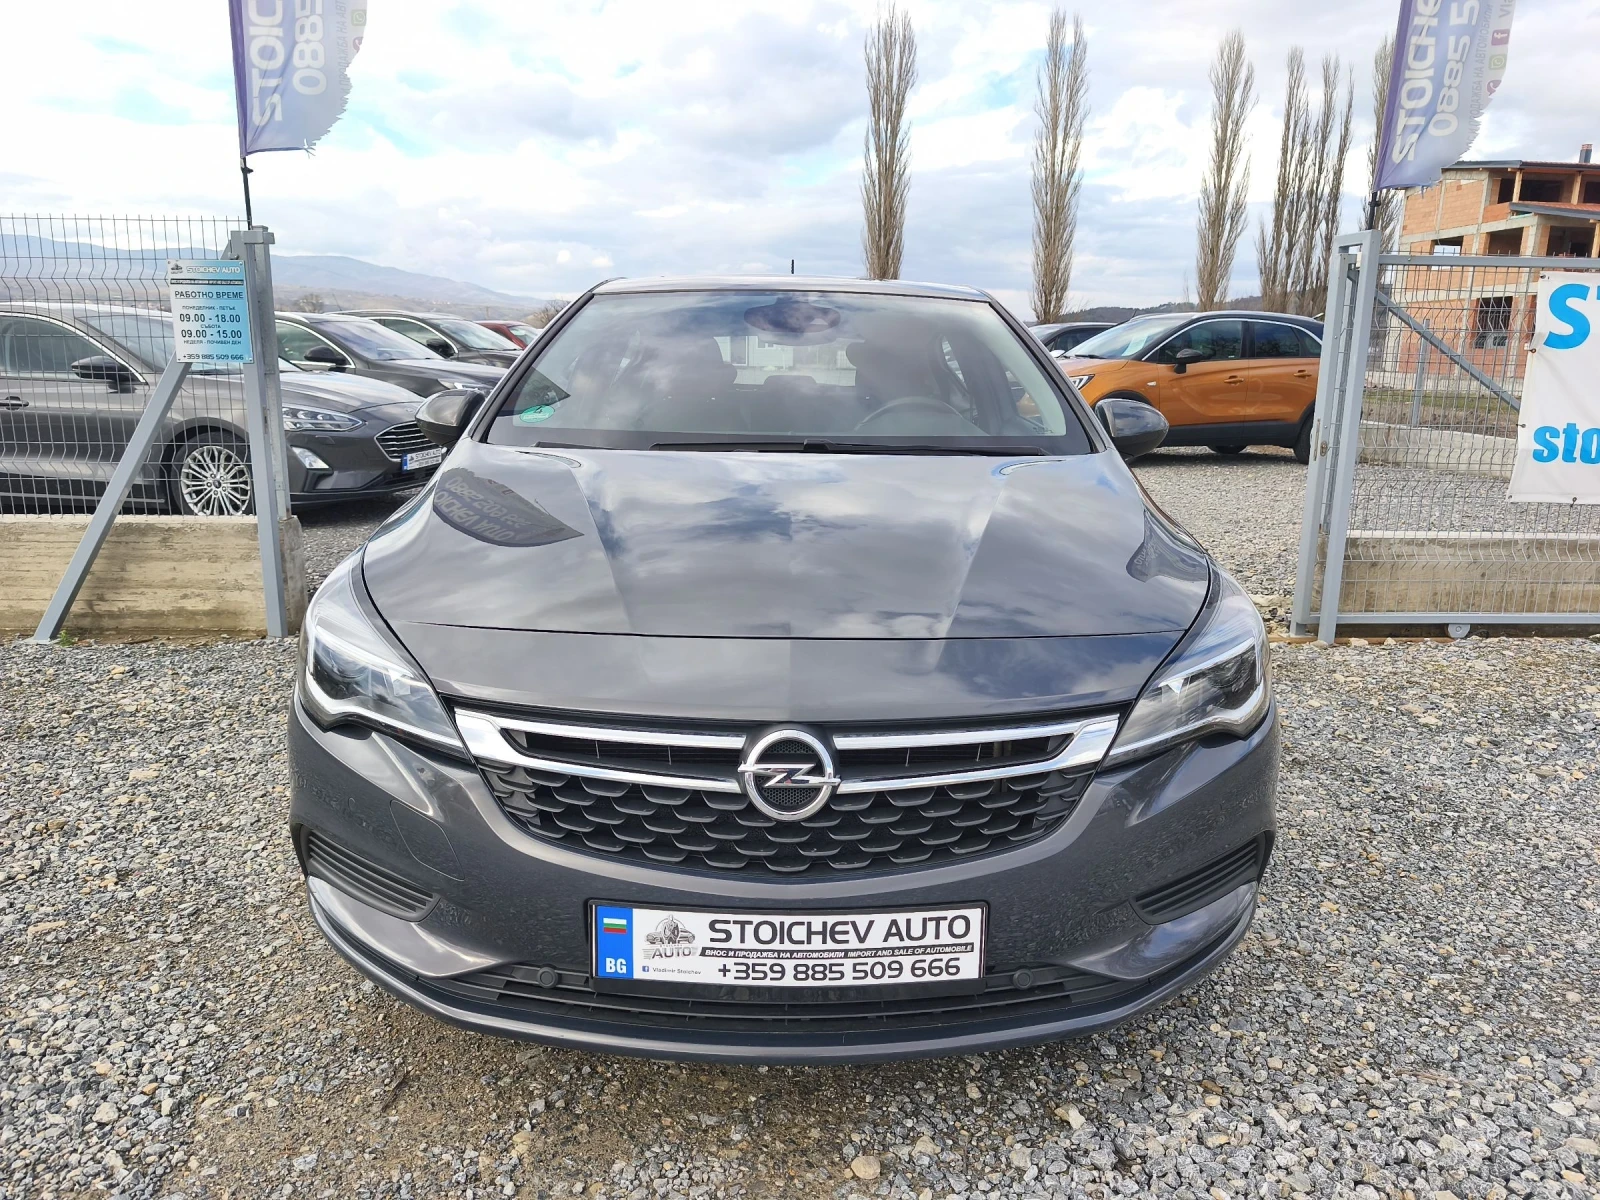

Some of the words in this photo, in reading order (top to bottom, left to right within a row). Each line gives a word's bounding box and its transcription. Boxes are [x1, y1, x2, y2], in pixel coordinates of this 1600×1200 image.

[1474, 64, 1485, 79] НА
[1428, 35, 1471, 136] 0885
[174, 290, 214, 298] РАБОТНО
[215, 291, 244, 299] ВРЕМЕ
[179, 313, 206, 323] 09.00
[214, 314, 241, 323] 18.00
[1543, 283, 1600, 350] S
[181, 329, 207, 338] 09.00
[216, 330, 242, 339] 15.00
[708, 919, 875, 945] STOICHEV
[882, 914, 971, 943] AUTO
[652, 947, 692, 959] AUTO
[705, 949, 727, 957] ВНОС
[735, 951, 778, 959] ПРОДАЖБА
[847, 950, 876, 958] IMPORT
[925, 944, 973, 954] AUTOMOBILE
[605, 957, 627, 974] BG
[718, 962, 786, 981] +359
[793, 962, 845, 981] 885
[852, 960, 904, 980] 509
[910, 957, 961, 978] 666
